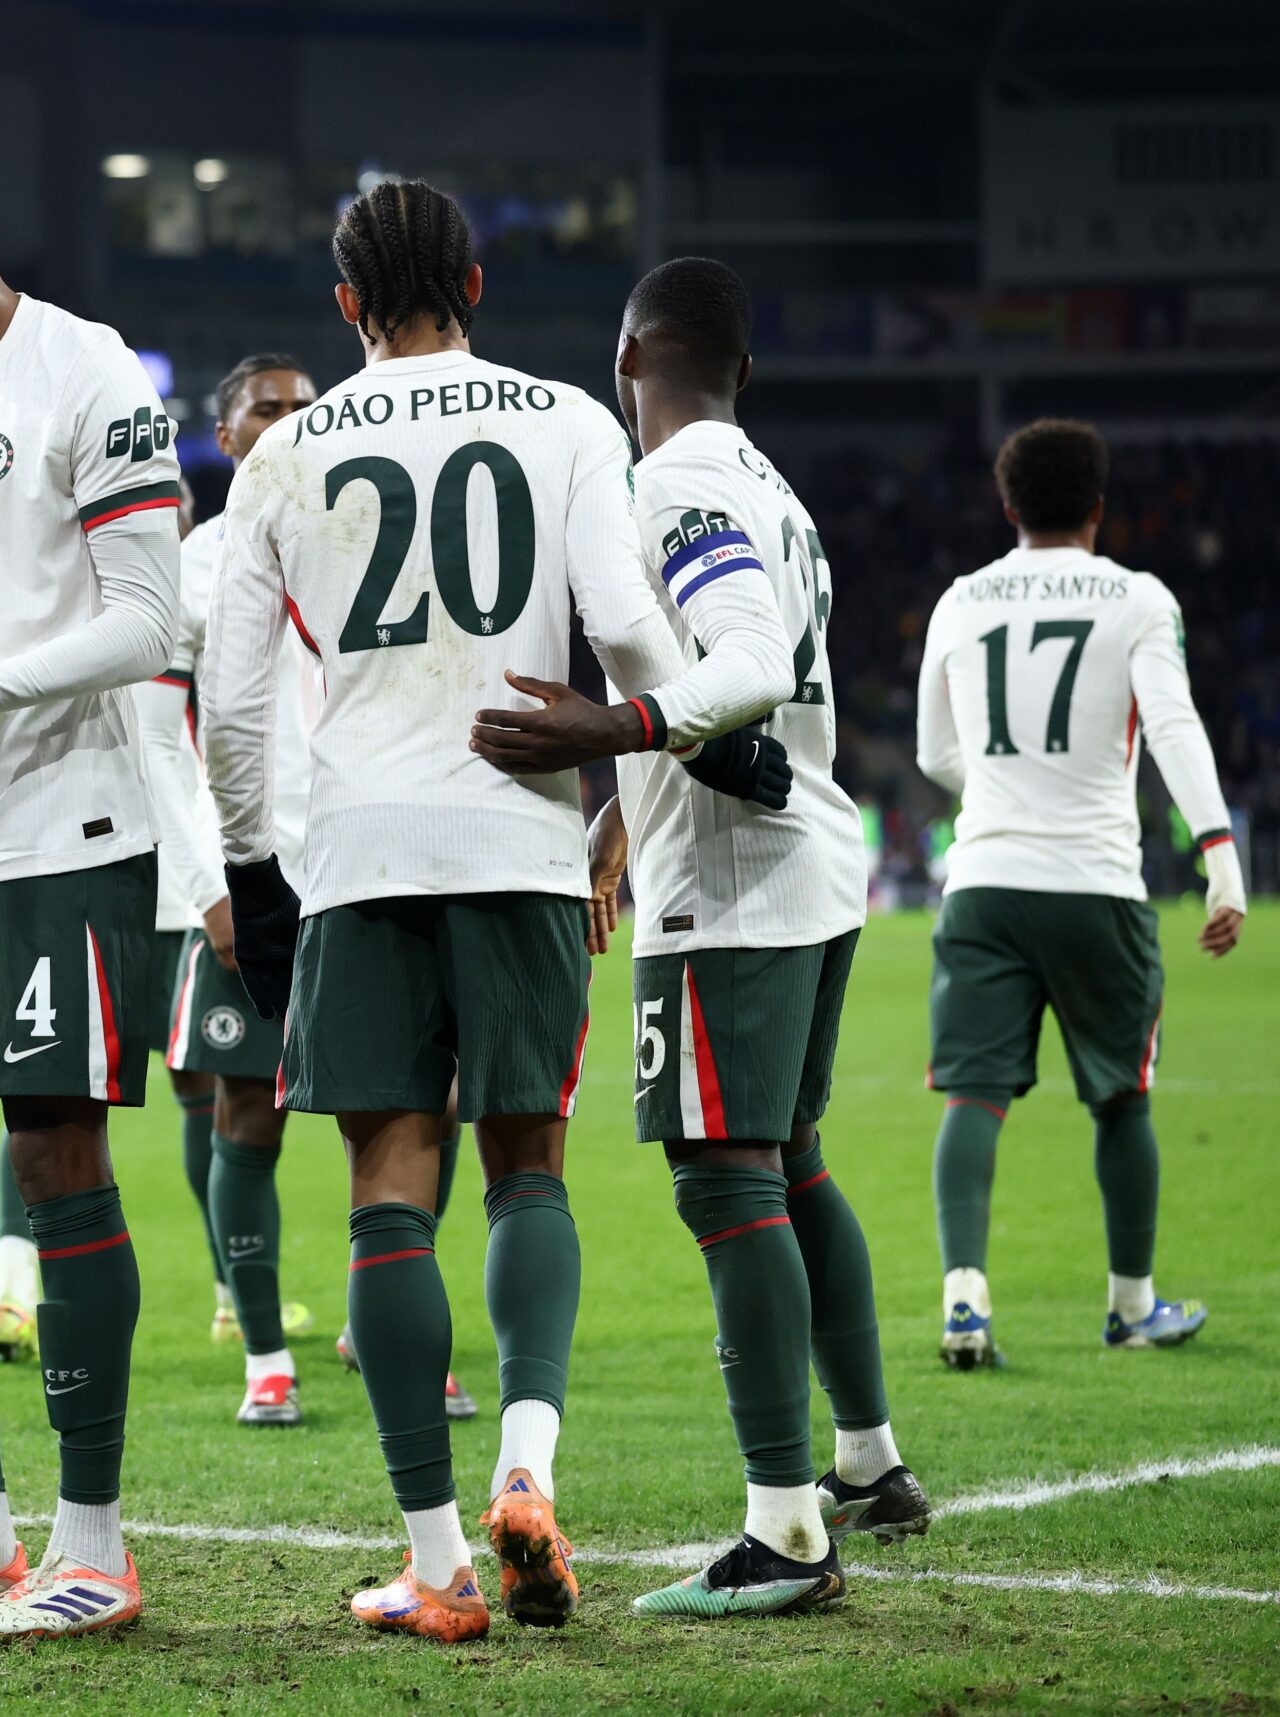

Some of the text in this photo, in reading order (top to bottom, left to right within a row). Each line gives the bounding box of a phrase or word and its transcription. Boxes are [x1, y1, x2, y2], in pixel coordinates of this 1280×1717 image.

[293, 380, 556, 448] JOÃO PEDRO
[325, 441, 536, 654] 20
[715, 549, 734, 559] EFL
[1040, 576, 1128, 600] SANTOS
[978, 618, 1096, 755] 17
[15, 956, 57, 1036] 4
[633, 996, 666, 1079] 5
[45, 1368, 89, 1382] CFC
